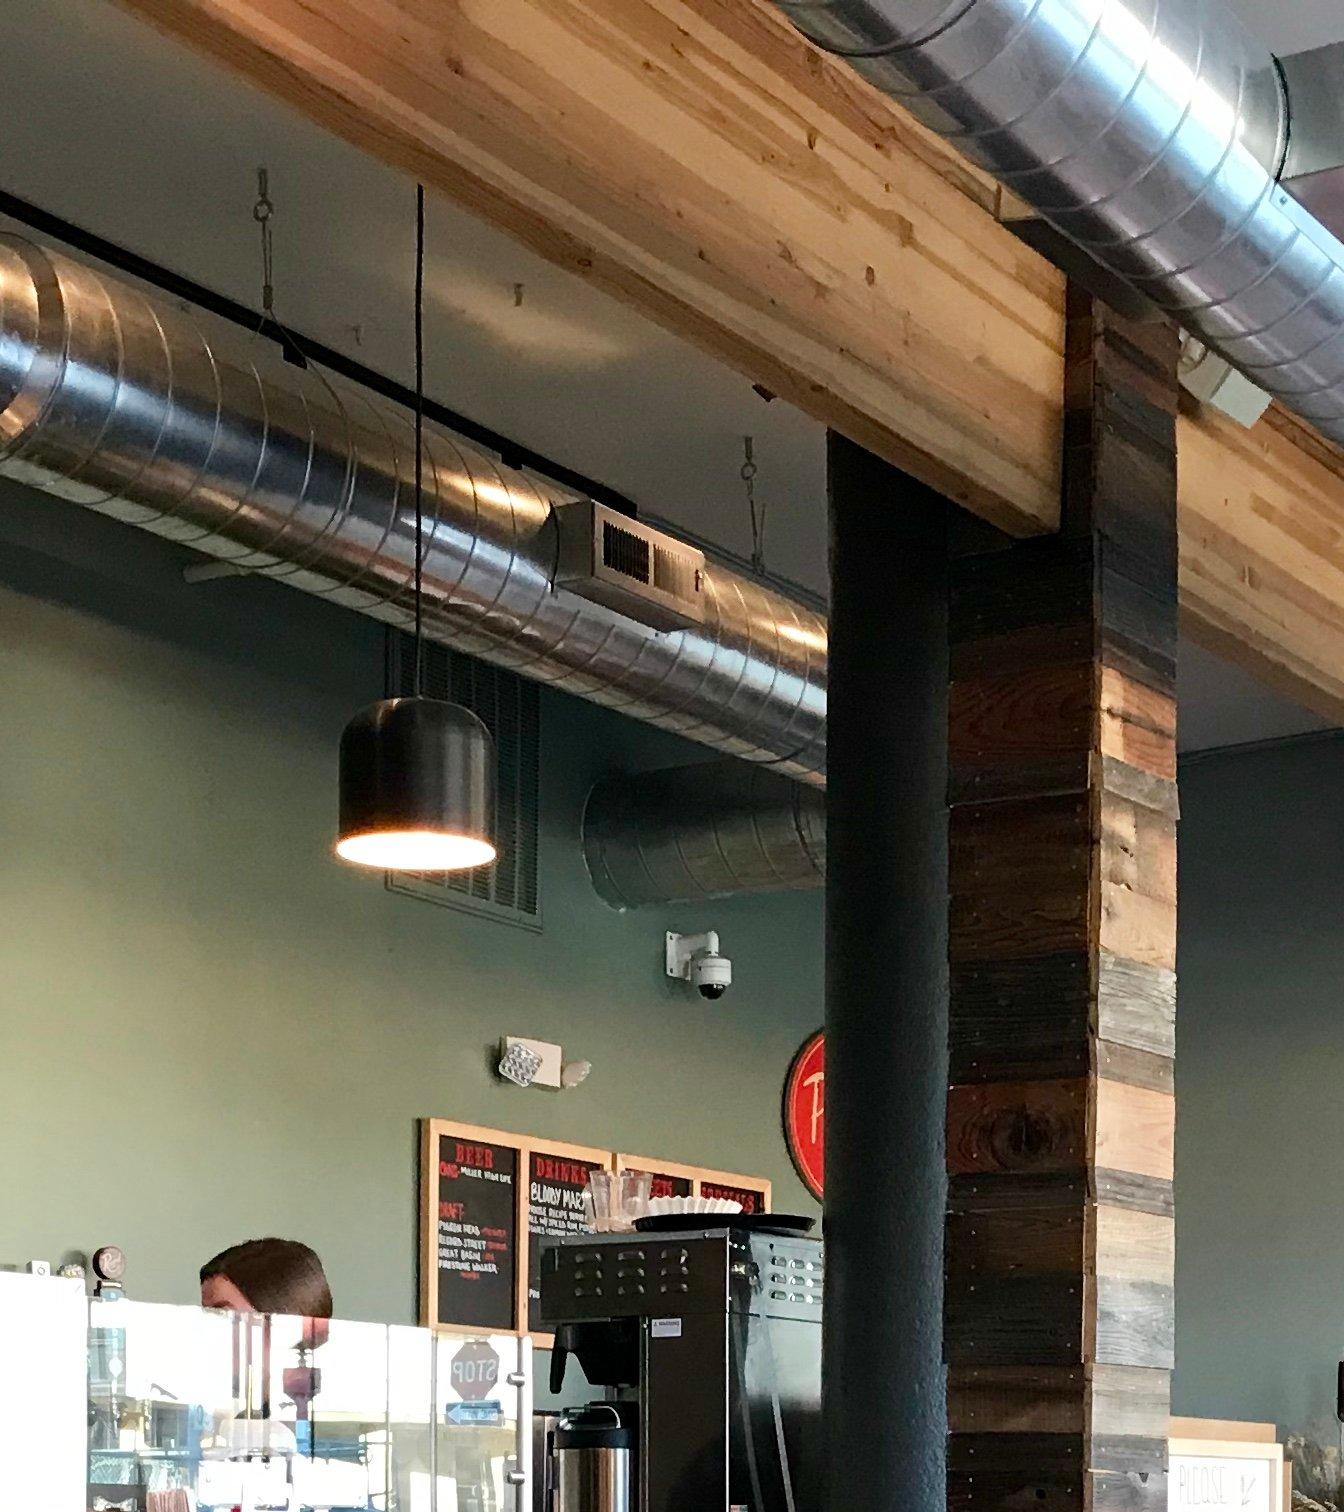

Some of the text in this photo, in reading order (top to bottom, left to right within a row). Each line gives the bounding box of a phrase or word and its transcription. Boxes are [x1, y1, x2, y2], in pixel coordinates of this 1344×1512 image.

[456, 1143, 493, 1168] BEER
[536, 1157, 588, 1187] DRINKS
[530, 1182, 562, 1206] BLOODY
[1179, 1464, 1227, 1505] PLEASE
